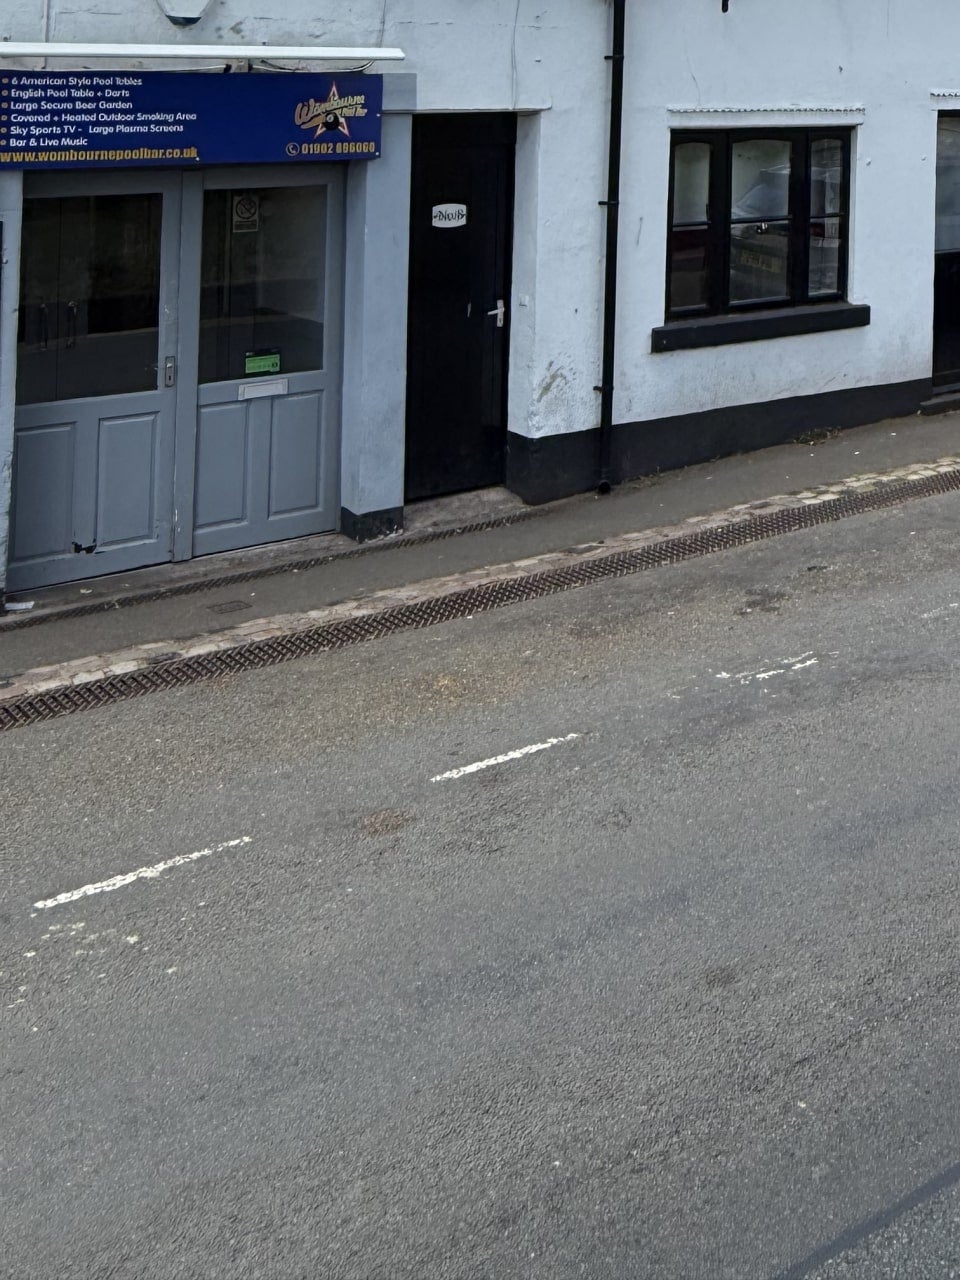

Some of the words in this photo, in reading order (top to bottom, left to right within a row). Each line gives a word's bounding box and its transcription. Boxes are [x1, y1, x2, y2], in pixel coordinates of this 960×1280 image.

[11, 77, 18, 85] 6
[20, 77, 66, 85] American
[68, 77, 91, 86] Style
[93, 77, 113, 85] Pool
[115, 77, 142, 85] Tables
[11, 89, 45, 99] English
[47, 89, 68, 97] Pool
[70, 89, 95, 97] Table
[105, 89, 130, 97] Darts
[10, 101, 38, 111] Large
[40, 101, 73, 109] Secure
[75, 101, 97, 109] Beer
[98, 101, 133, 109] Garden
[11, 113, 51, 122] Covered
[61, 113, 97, 121] Heated
[98, 113, 135, 121] Outdoor
[136, 113, 174, 122] Smoking
[176, 112, 197, 120] Area
[10, 126, 28, 136] Sky
[30, 126, 61, 135] Sports
[63, 125, 76, 133] TV
[88, 125, 114, 135] Large
[115, 124, 148, 133] Plasma
[150, 124, 184, 132] Screens
[9, 138, 26, 147] Bar
[29, 138, 37, 147] &
[40, 138, 59, 146] Live
[61, 137, 88, 146] Music
[0, 147, 197, 162] www.wombournepoolbar.co.uk
